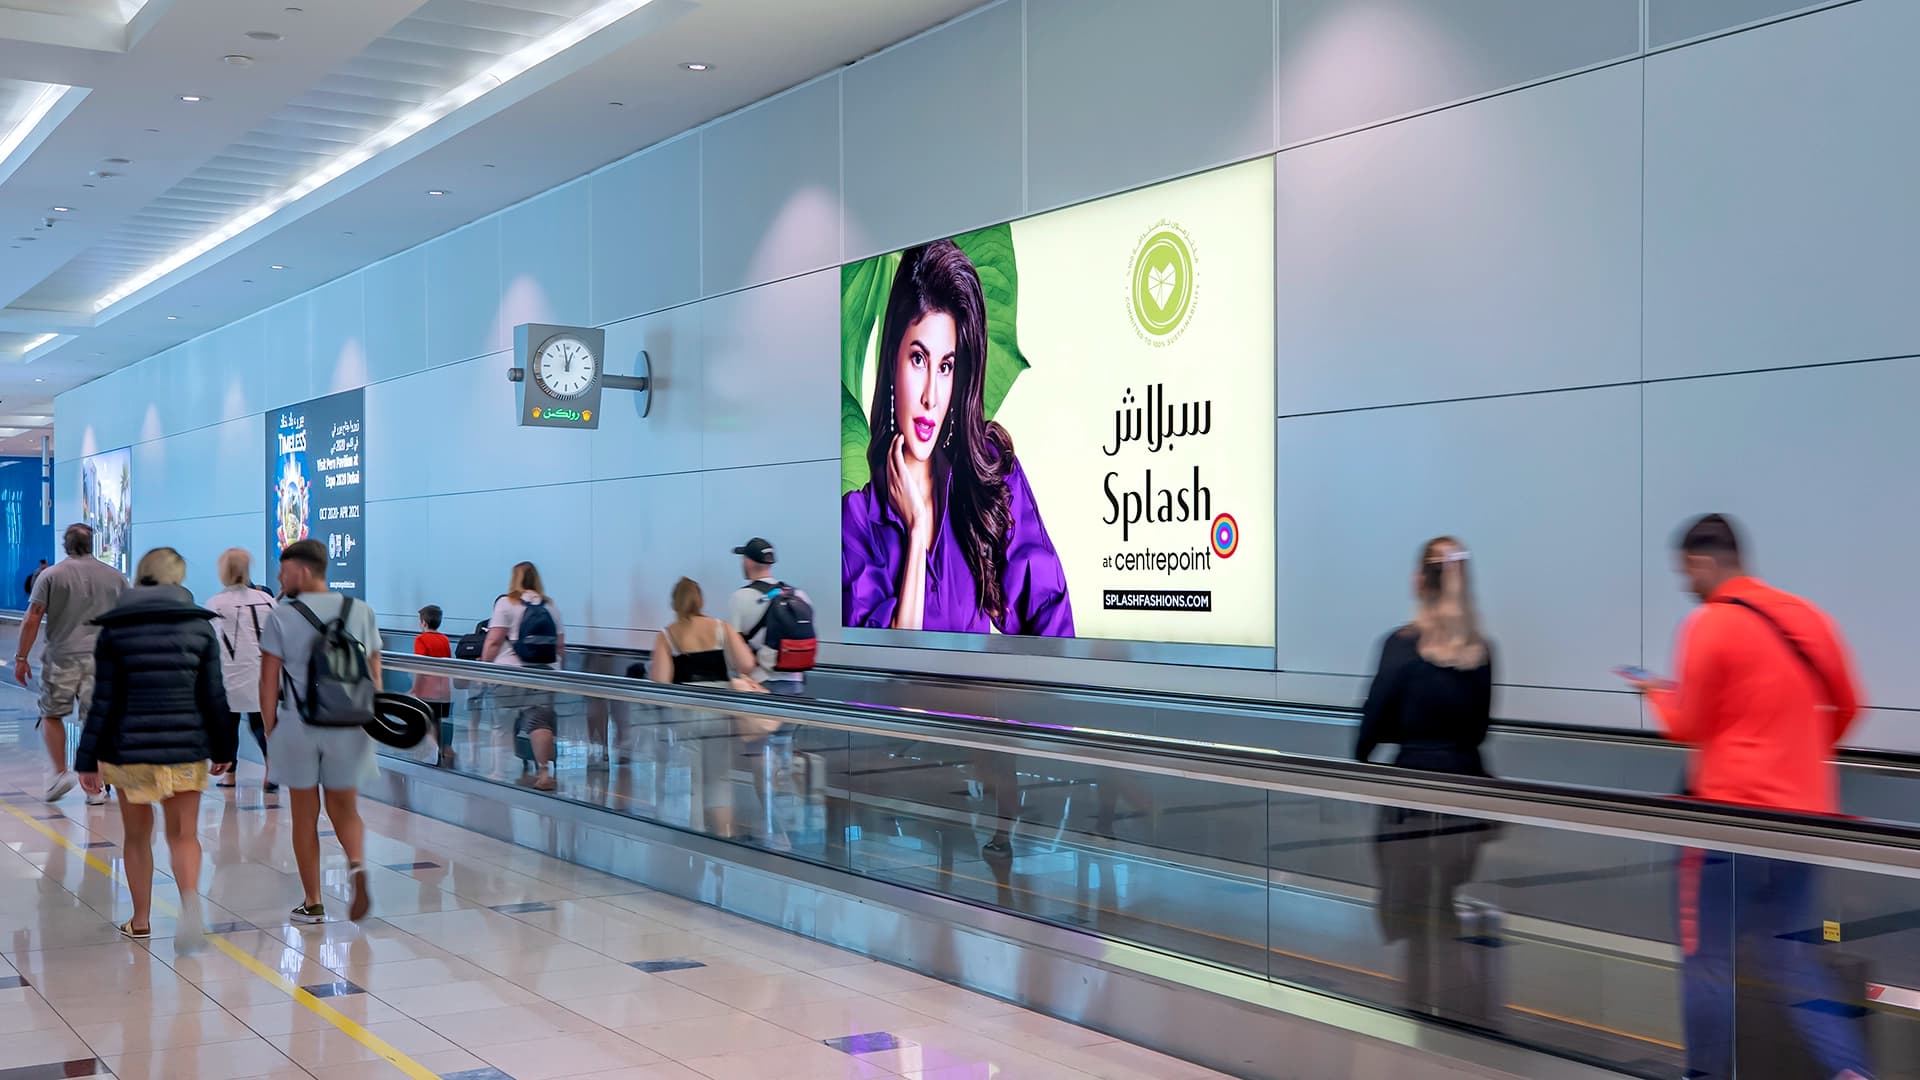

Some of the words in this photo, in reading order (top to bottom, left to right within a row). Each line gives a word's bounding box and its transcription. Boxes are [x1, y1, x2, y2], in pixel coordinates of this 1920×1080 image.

[1125, 296, 1145, 340] COMMITTED
[1167, 284, 1200, 346] SUSTAINABILITY
[1102, 383, 1211, 456] سبلاش
[278, 429, 307, 457] TIMELESS
[316, 458, 327, 472] Visit
[326, 457, 336, 470] Peru
[336, 454, 353, 469] Pavilion
[353, 453, 359, 467] at
[325, 475, 336, 489] Expo
[336, 472, 347, 486] 2020
[346, 470, 360, 485] Dubai
[319, 507, 327, 520] OCT
[339, 505, 349, 519] APR
[348, 504, 360, 518] 2021
[1102, 465, 1211, 541] Splash
[1102, 555, 1112, 568] at
[1115, 546, 1211, 576] centrepoint
[1105, 594, 1209, 608] SPLASHFASHIONS.COM
